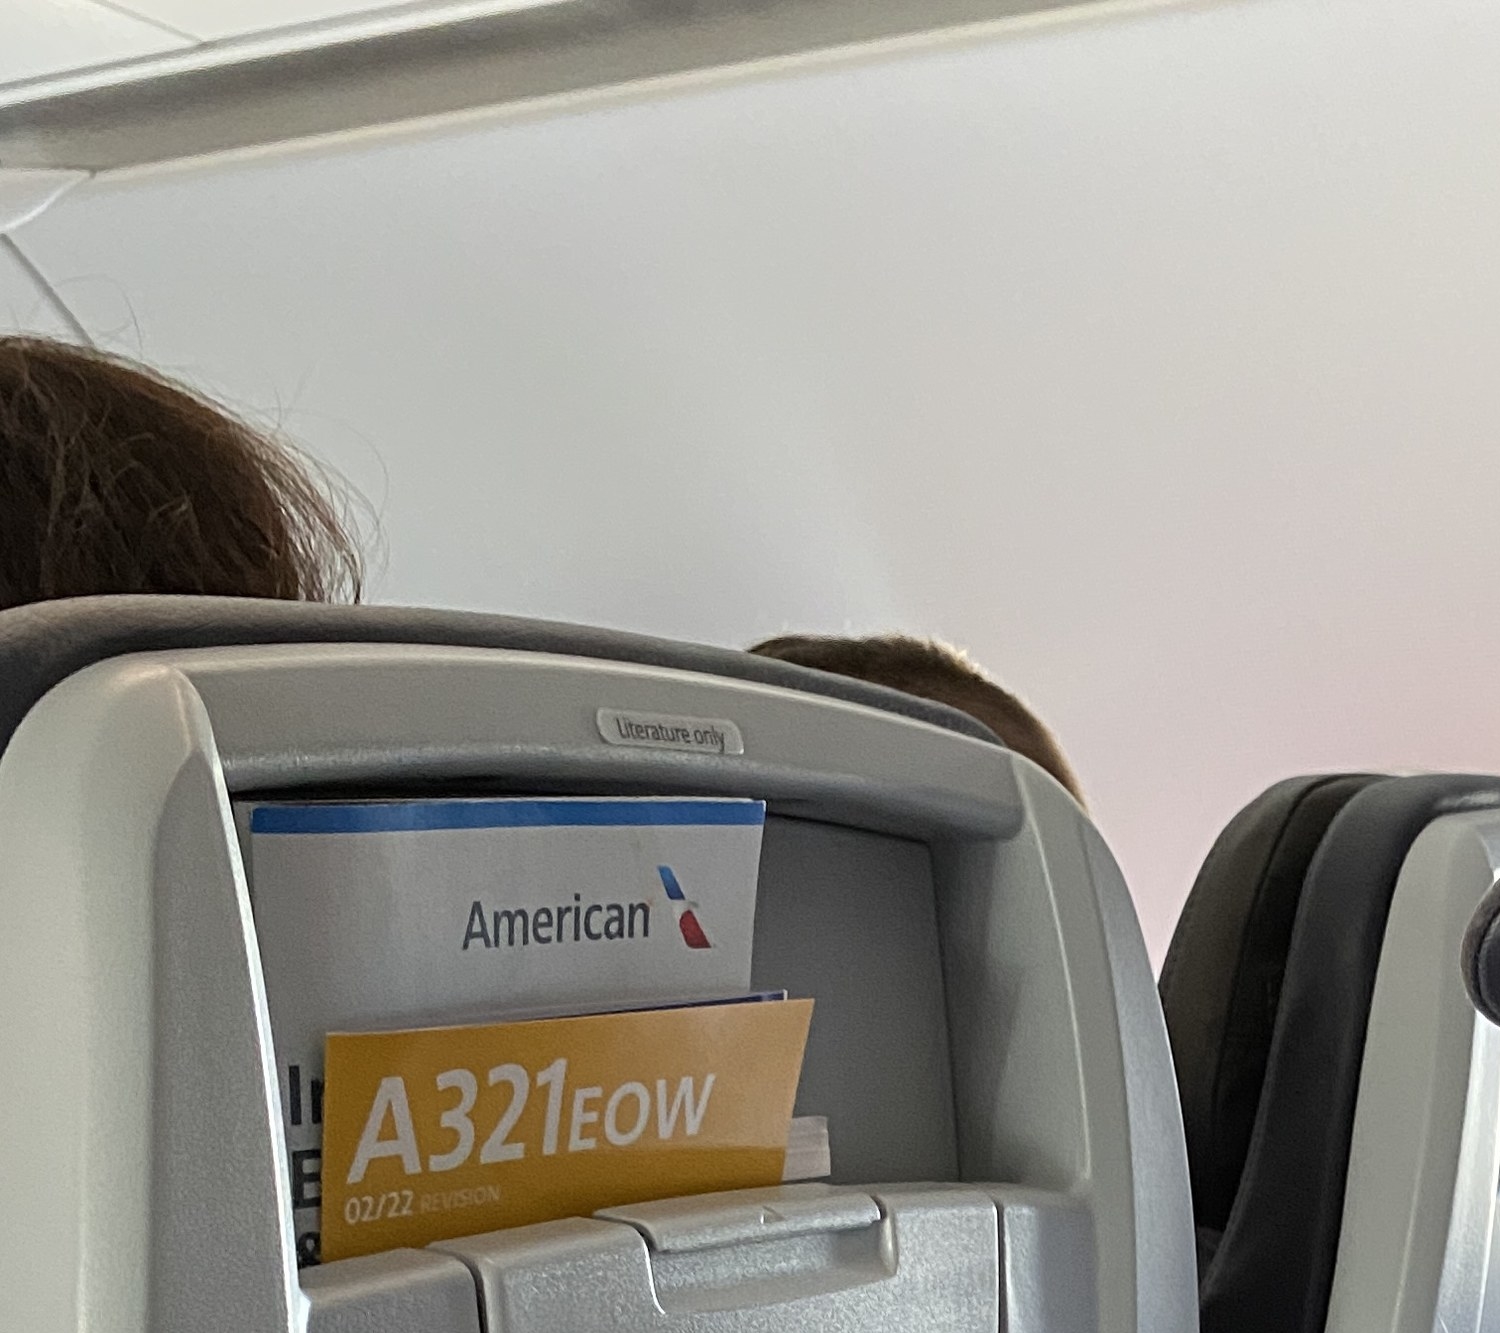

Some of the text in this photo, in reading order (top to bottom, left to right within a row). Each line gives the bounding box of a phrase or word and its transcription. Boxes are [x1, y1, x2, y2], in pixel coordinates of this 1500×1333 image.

[615, 716, 725, 754] Literature only
[462, 892, 651, 950] American
[344, 1185, 501, 1225] 02/22 REVISION
